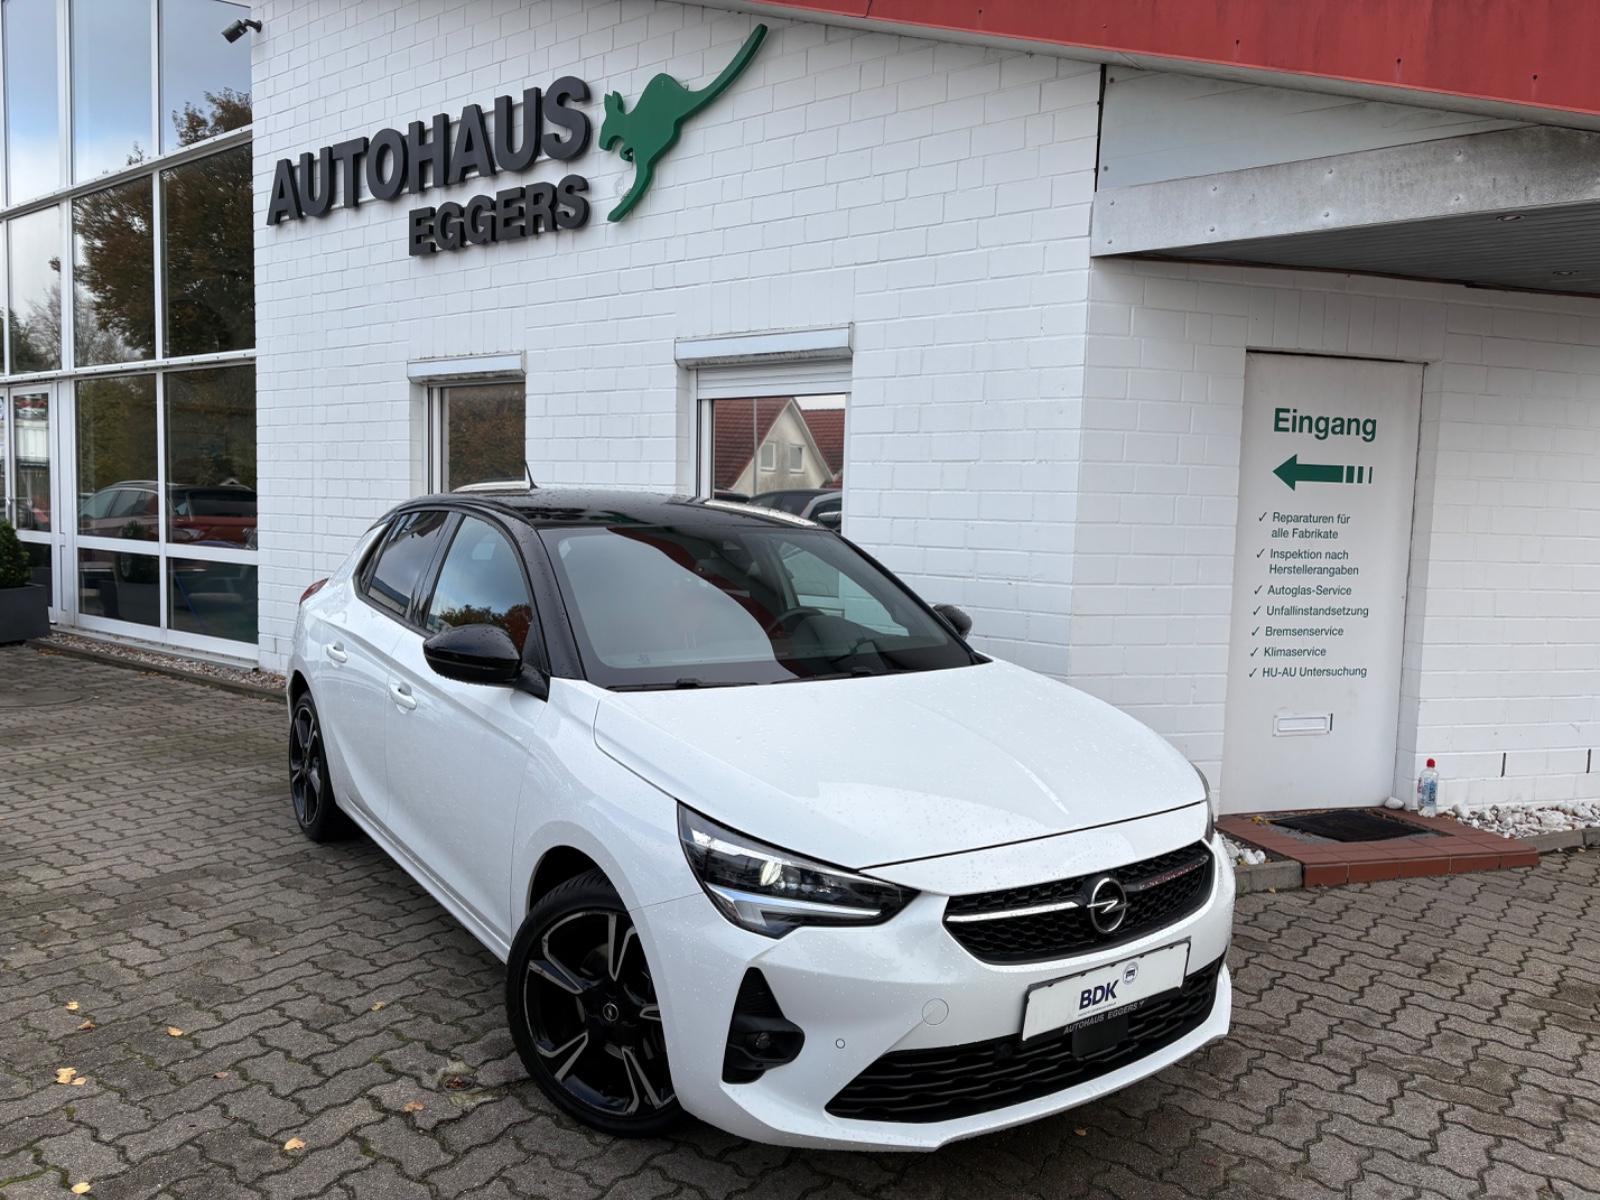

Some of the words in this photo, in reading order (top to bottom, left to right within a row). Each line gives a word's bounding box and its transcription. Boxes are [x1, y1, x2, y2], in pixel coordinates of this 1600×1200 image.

[267, 75, 592, 226] AUTOHAUS
[408, 174, 590, 257] EGGERS
[1273, 407, 1377, 443] Eingang
[1272, 512, 1334, 525] Reparaturen
[1337, 513, 1351, 525] für
[1271, 528, 1289, 538] alle
[1292, 528, 1339, 540] Fabrikate
[1270, 549, 1322, 561] Inspektion
[1325, 550, 1349, 560] nach
[1269, 564, 1359, 577] Herstellerangaben
[1267, 585, 1352, 597] Autoglas-Service
[1266, 605, 1369, 618] Unfallinstandsetzung
[1265, 626, 1344, 637] Bremsenservice
[1264, 646, 1326, 657] Klimaservice
[1262, 667, 1297, 678] HU-AU
[1299, 667, 1367, 678] Untersuchung
[1079, 979, 1119, 1010] BDK
[1063, 1014, 1104, 1035] AUTOHAUS
[1107, 1003, 1138, 1020] EGGERS
